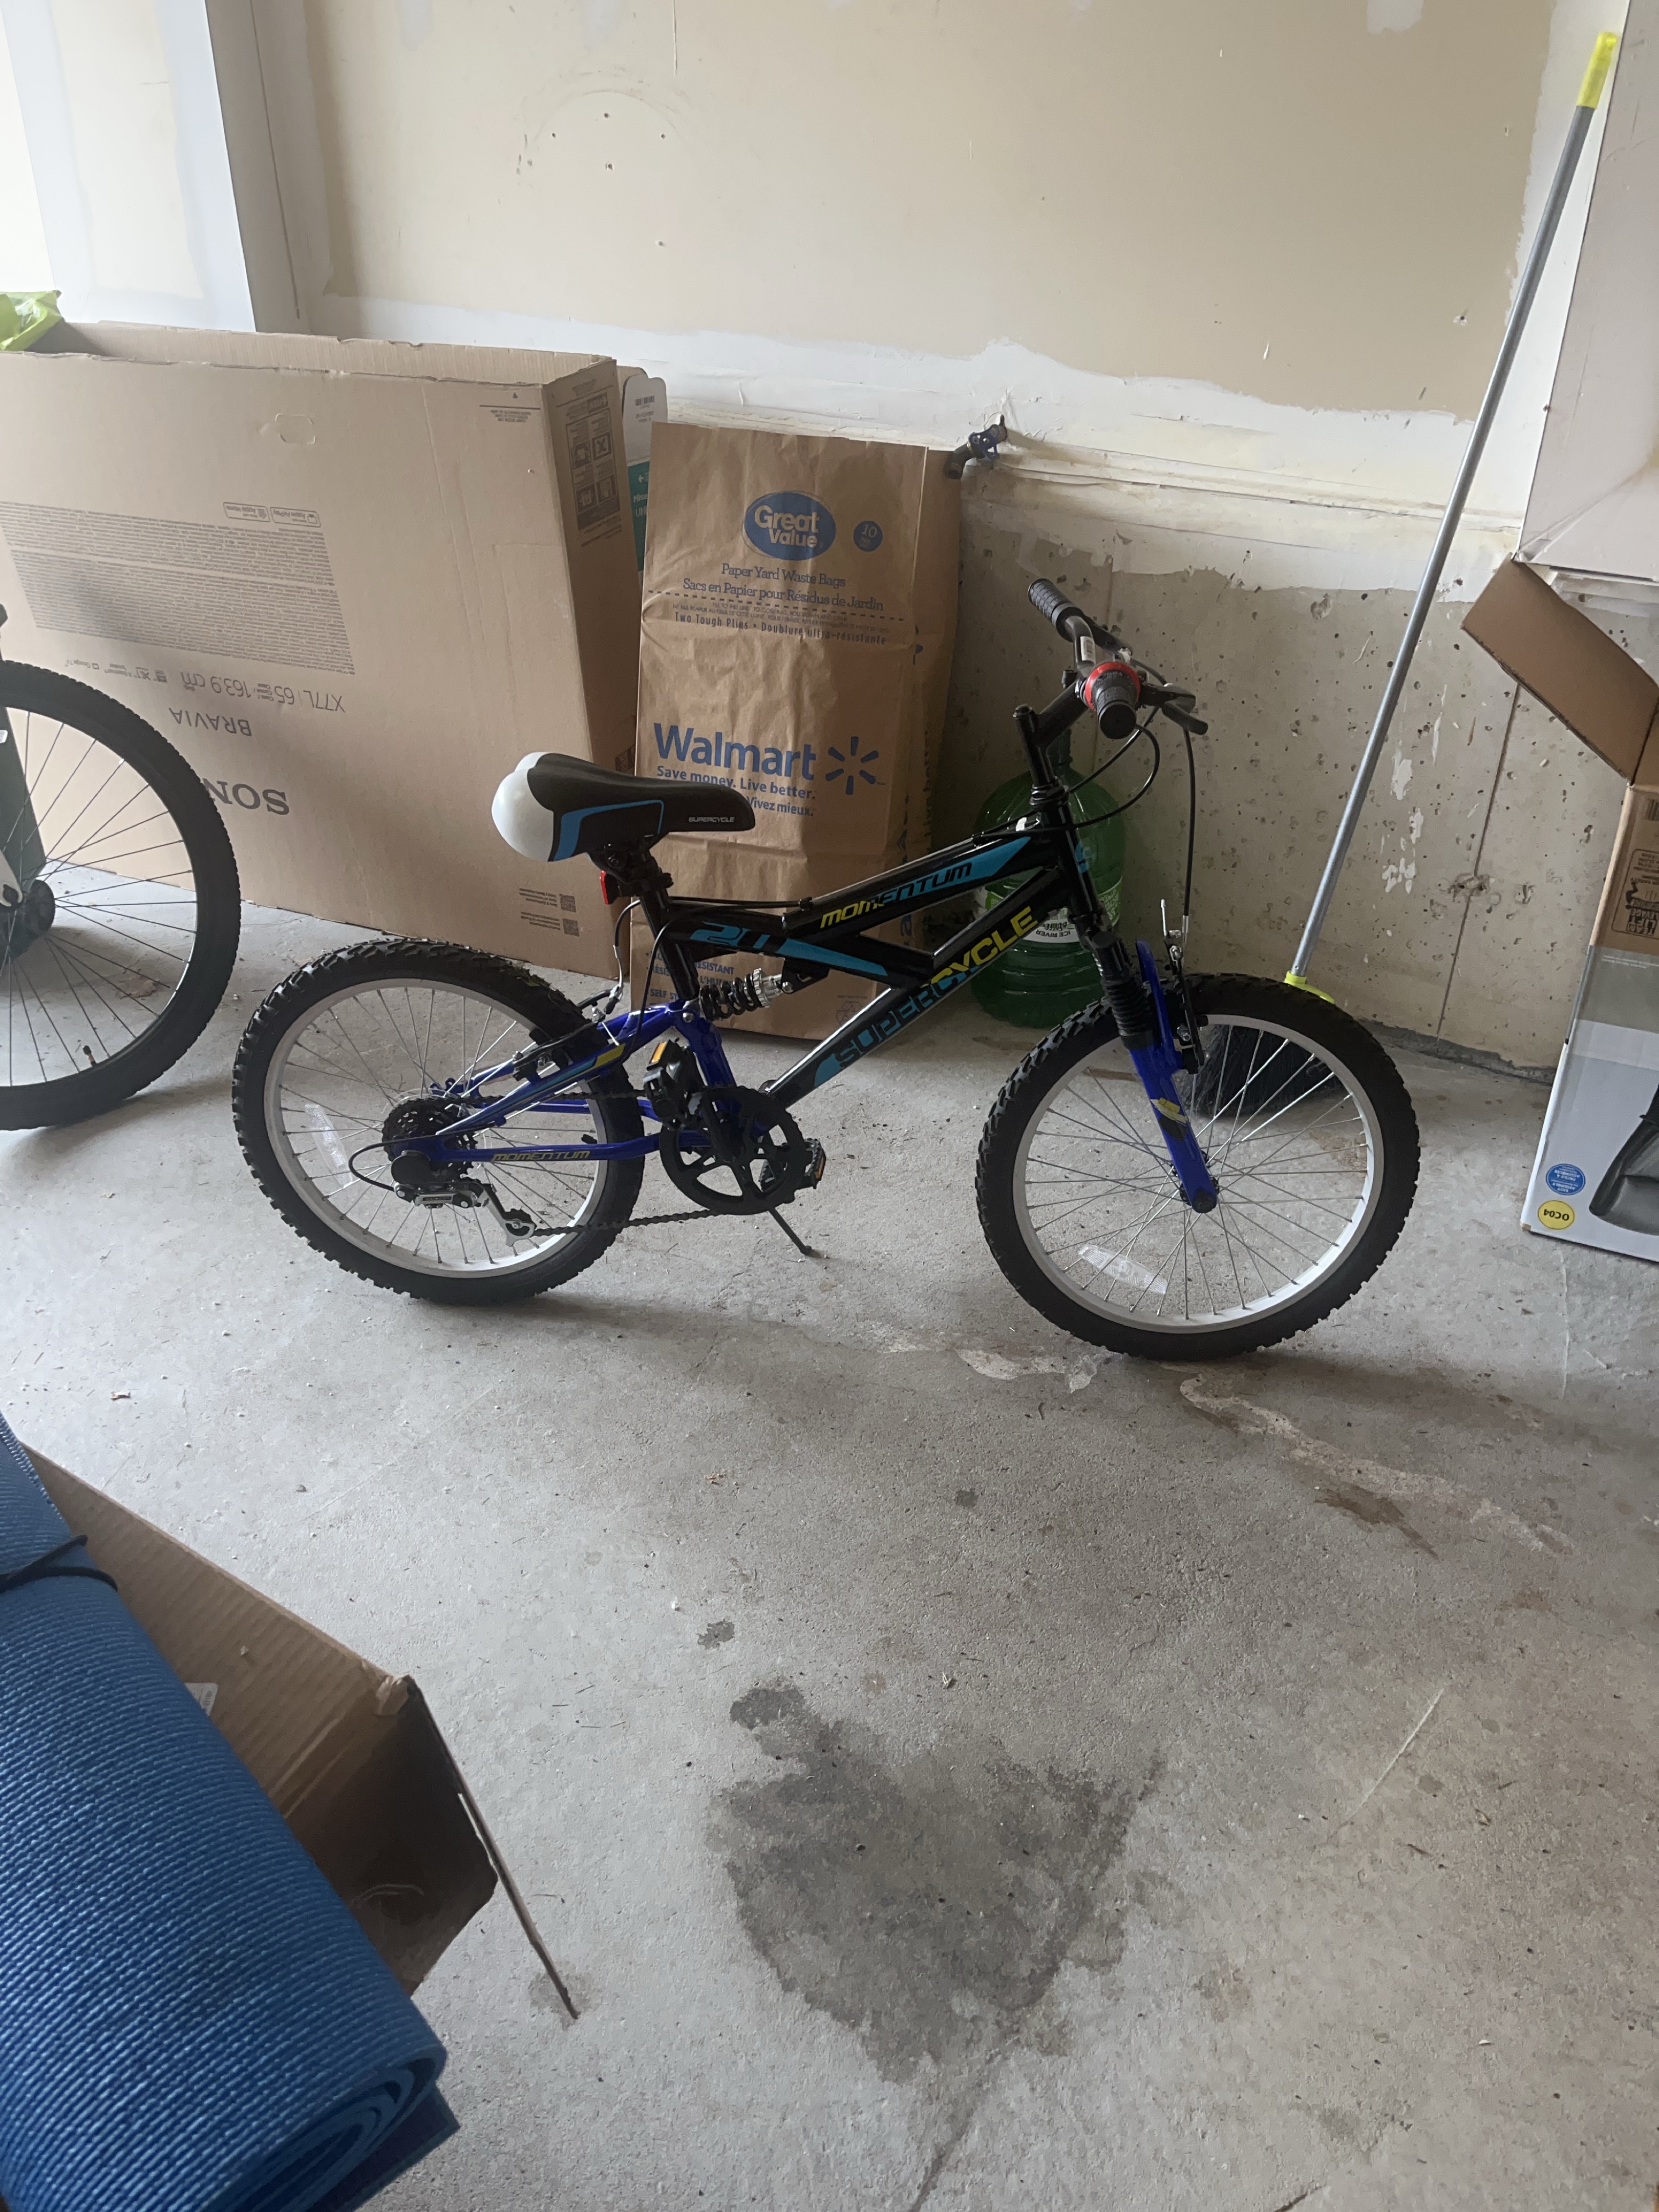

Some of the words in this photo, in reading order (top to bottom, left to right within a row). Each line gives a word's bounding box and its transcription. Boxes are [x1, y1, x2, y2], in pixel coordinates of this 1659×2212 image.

[755, 505, 820, 533] Great
[769, 528, 818, 548] Value
[721, 563, 753, 579] Paper
[754, 566, 780, 580] Yard
[781, 569, 817, 584] Waste
[819, 573, 846, 589] Bags
[683, 578, 707, 591] Sacs
[708, 584, 721, 593] en
[723, 582, 758, 599] Papier
[758, 589, 785, 601] pour
[787, 589, 830, 605] Résidus
[831, 592, 846, 607] de
[847, 595, 884, 611] Jardin
[675, 611, 691, 623] Two
[695, 613, 722, 628] Tough
[726, 618, 748, 630] Plies
[761, 621, 803, 636] Doublure
[807, 627, 887, 646] ultra-résistante
[180, 671, 205, 687] cm
[210, 676, 252, 698] 163.9
[274, 686, 295, 705] 65
[303, 690, 346, 713] X77L
[168, 707, 252, 737] BRAVIA
[653, 722, 817, 781] Walmart
[656, 765, 687, 780] Save
[740, 777, 767, 793] Live
[770, 781, 816, 800] better.
[202, 777, 290, 816] SON
[776, 802, 814, 816] mieux.
[820, 862, 972, 929] MOMENTUM
[1035, 929, 1057, 938] RIVER
[1626, 923, 1655, 937] TEAM
[650, 988, 667, 998] SELF
[834, 906, 1038, 1068] SUPERCYCLE
[490, 1151, 591, 1162] MOMENTUM
[1543, 1208, 1570, 1221] OC04
